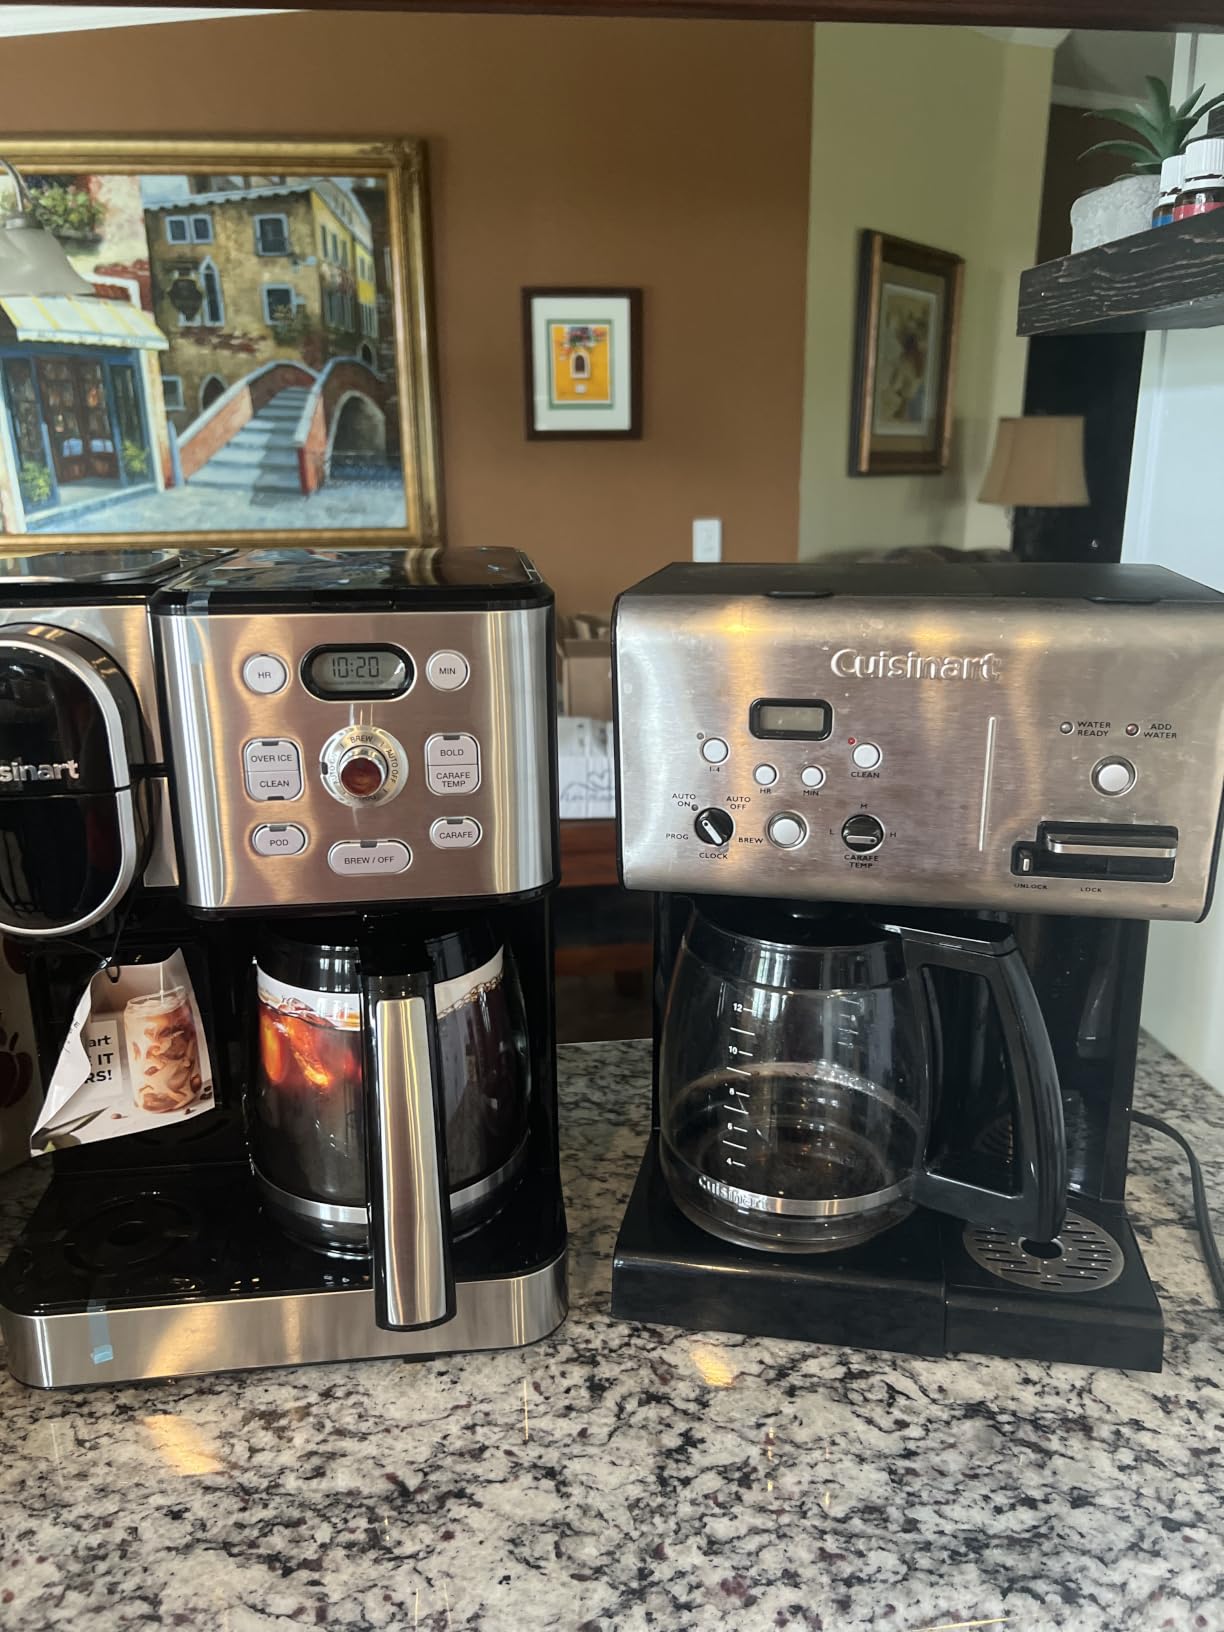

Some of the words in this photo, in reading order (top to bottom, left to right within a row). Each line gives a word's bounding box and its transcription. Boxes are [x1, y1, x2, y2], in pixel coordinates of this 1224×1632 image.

[332, 656, 379, 678] 10:20
[830, 648, 1001, 679] Cuisinart
[439, 667, 456, 675] MIN
[258, 671, 272, 680] HR
[1077, 721, 1111, 729] WATER
[1150, 723, 1172, 731] ADD
[1077, 729, 1109, 737] READY
[1144, 731, 1177, 739] WATER
[350, 735, 373, 743] BREW
[440, 748, 464, 757] BOLD
[250, 754, 274, 762] OVER
[276, 754, 293, 762] ICE
[386, 749, 399, 768] AUTO
[391, 770, 399, 783] OFF
[436, 772, 470, 780] CARAFE
[851, 771, 880, 779] CLEAN
[259, 780, 290, 788] CLEAN
[442, 780, 466, 788] TEMP
[726, 796, 751, 804] AUTO
[439, 831, 473, 840] CARAFE
[270, 839, 289, 847] POD
[699, 852, 728, 860] CLOCK
[844, 854, 879, 862] CARAFE
[344, 857, 370, 865] BREW
[377, 856, 395, 864] OFF
[733, 1003, 743, 1012] 12
[728, 1046, 738, 1055] 10
[98, 1053, 114, 1065] IT
[699, 1175, 767, 1211] Cuisinart
